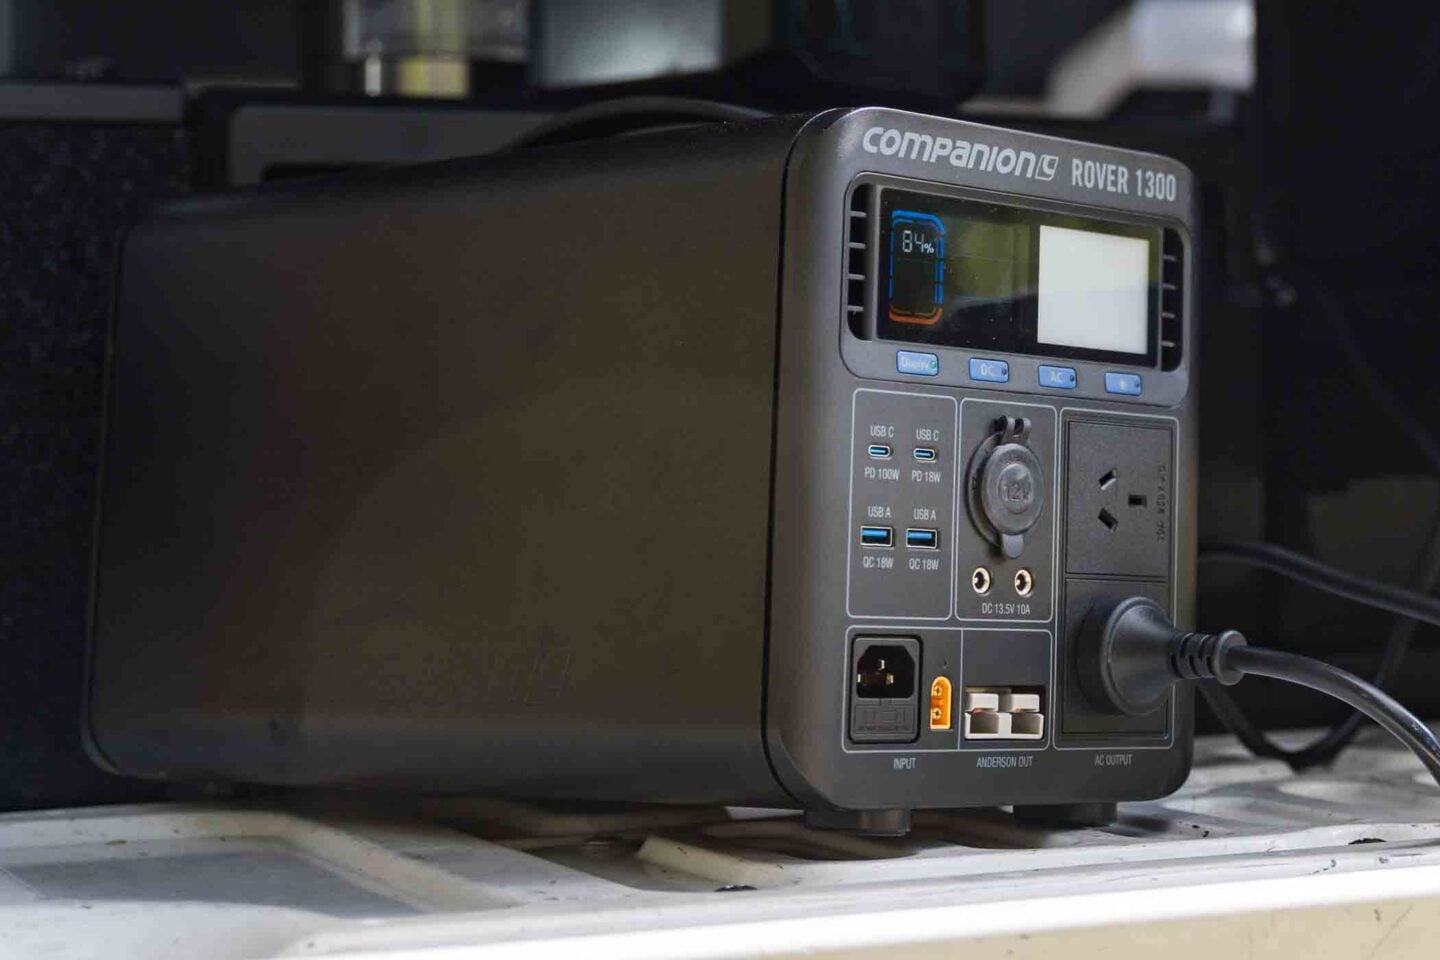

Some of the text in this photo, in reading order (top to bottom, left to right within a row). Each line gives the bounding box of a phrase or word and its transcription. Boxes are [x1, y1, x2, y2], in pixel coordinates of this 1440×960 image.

[1071, 158, 1128, 195] ROVER
[1135, 167, 1177, 202] 1300
[979, 363, 995, 377] DC
[1050, 370, 1064, 384] AC
[870, 425, 895, 438] USB C
[915, 427, 939, 441] USB C
[864, 467, 900, 481] PD 100W
[911, 470, 941, 484] PD 18W
[868, 505, 892, 519] USB A
[913, 507, 937, 521] USB A
[863, 556, 894, 569] QC 18W
[922, 559, 939, 571] 18W
[982, 602, 1031, 616] DC 13.5V 10A
[893, 757, 917, 769] INPUT
[976, 755, 1034, 769] ANDERSON OUT
[1094, 753, 1134, 766] AC OUTPUT
